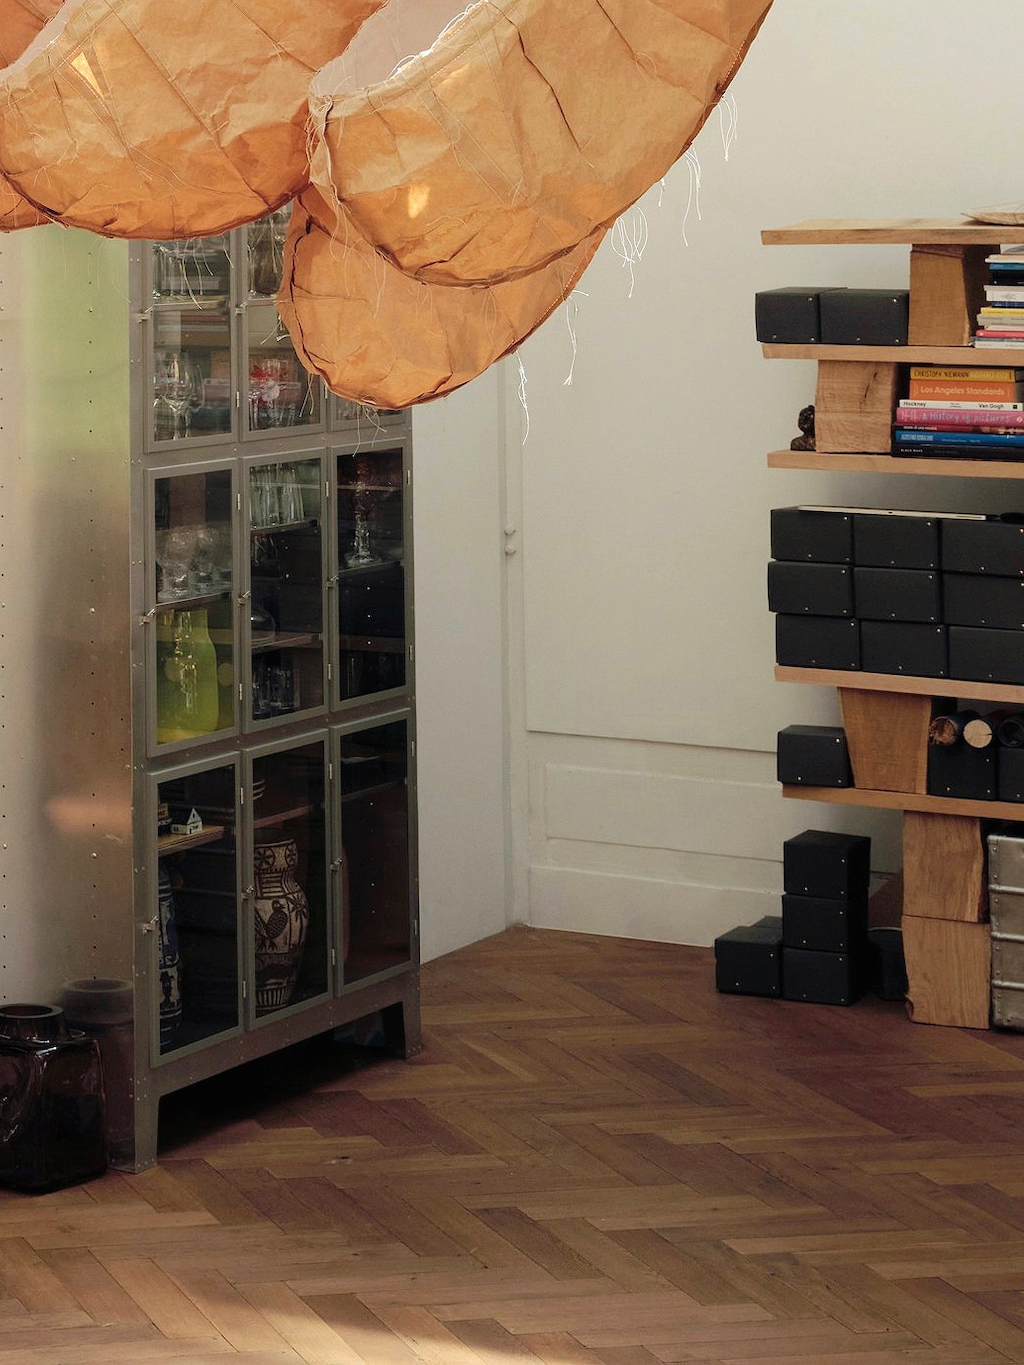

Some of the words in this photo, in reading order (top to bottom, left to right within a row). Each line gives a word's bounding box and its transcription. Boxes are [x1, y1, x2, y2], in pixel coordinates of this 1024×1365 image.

[935, 387, 964, 395] Angeles
[966, 388, 1005, 396] Standards
[930, 412, 960, 424] History
[972, 414, 1009, 424] pictures
